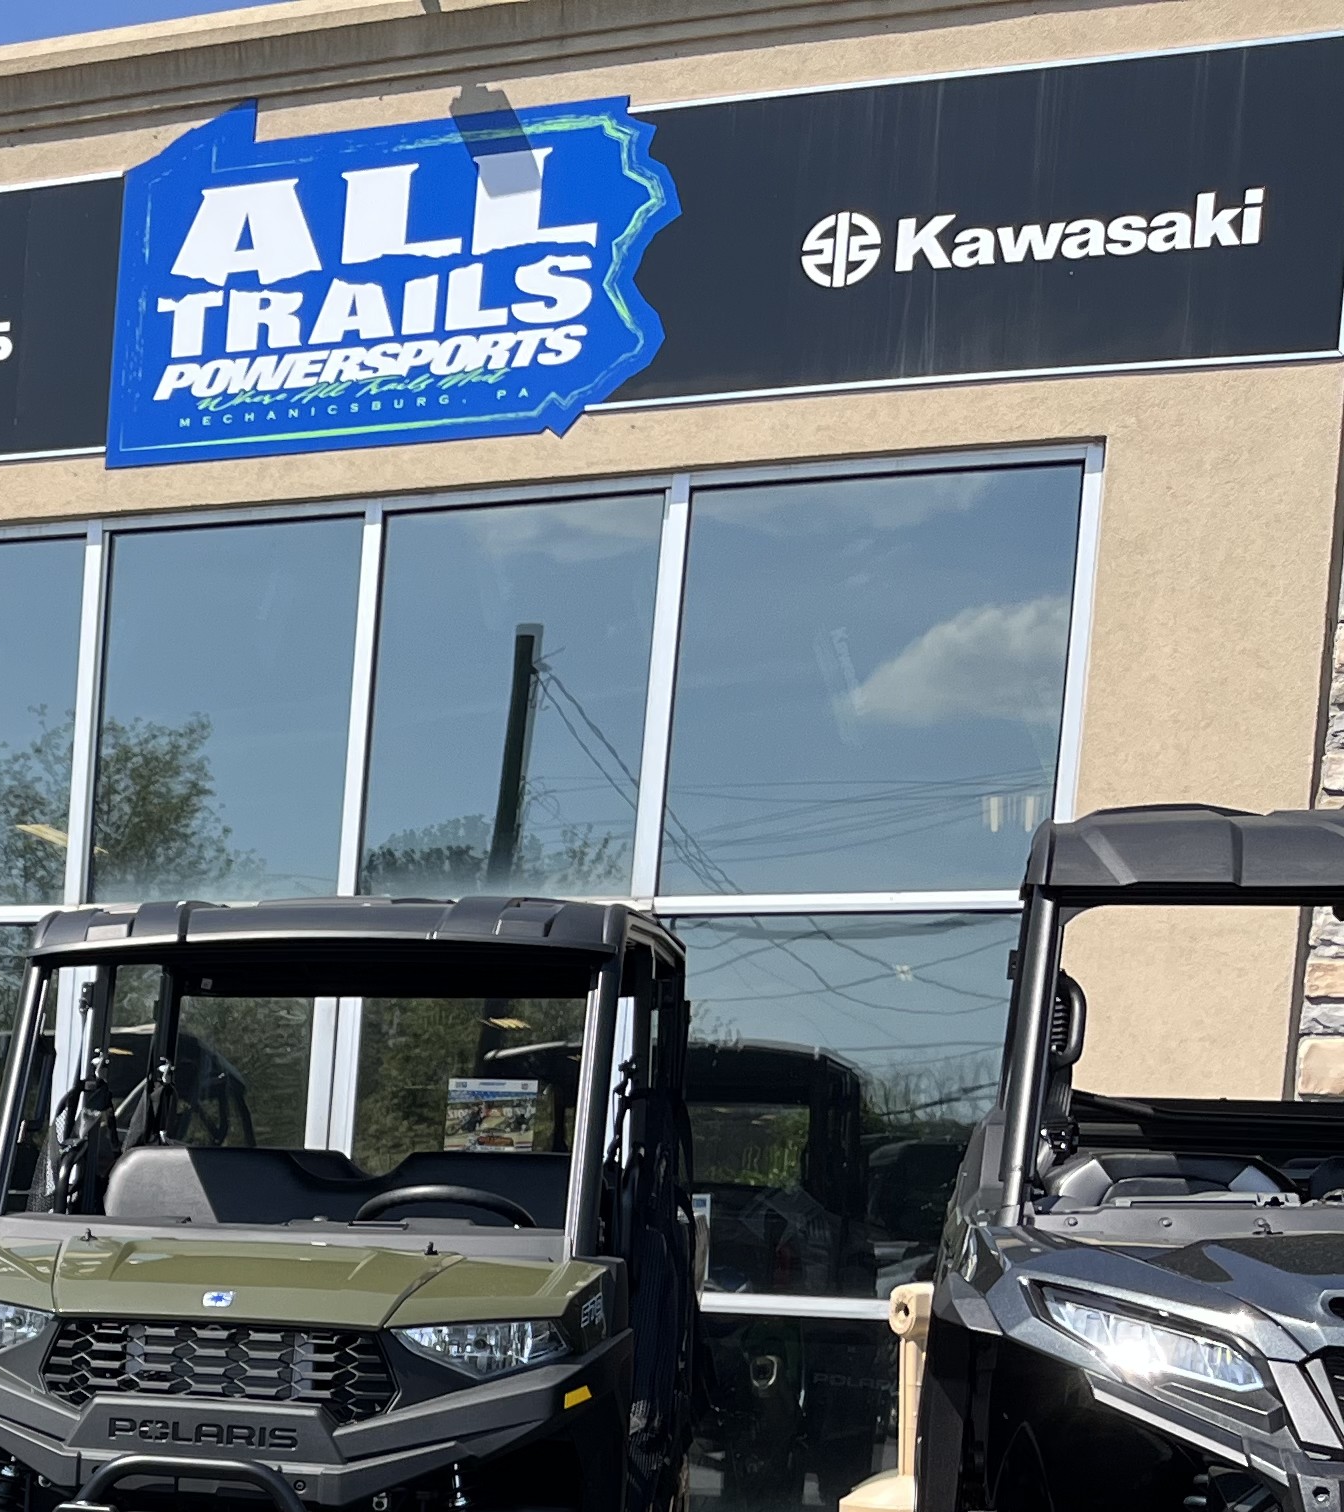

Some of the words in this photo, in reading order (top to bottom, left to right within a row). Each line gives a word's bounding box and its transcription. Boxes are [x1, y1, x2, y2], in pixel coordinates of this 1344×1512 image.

[170, 147, 598, 287] ALL
[895, 186, 1266, 272] Kawasaki
[157, 255, 593, 358] TRAILS
[153, 324, 588, 400] POWERSPORTS
[497, 388, 529, 400] PA
[108, 1417, 298, 1450] POLARIS
